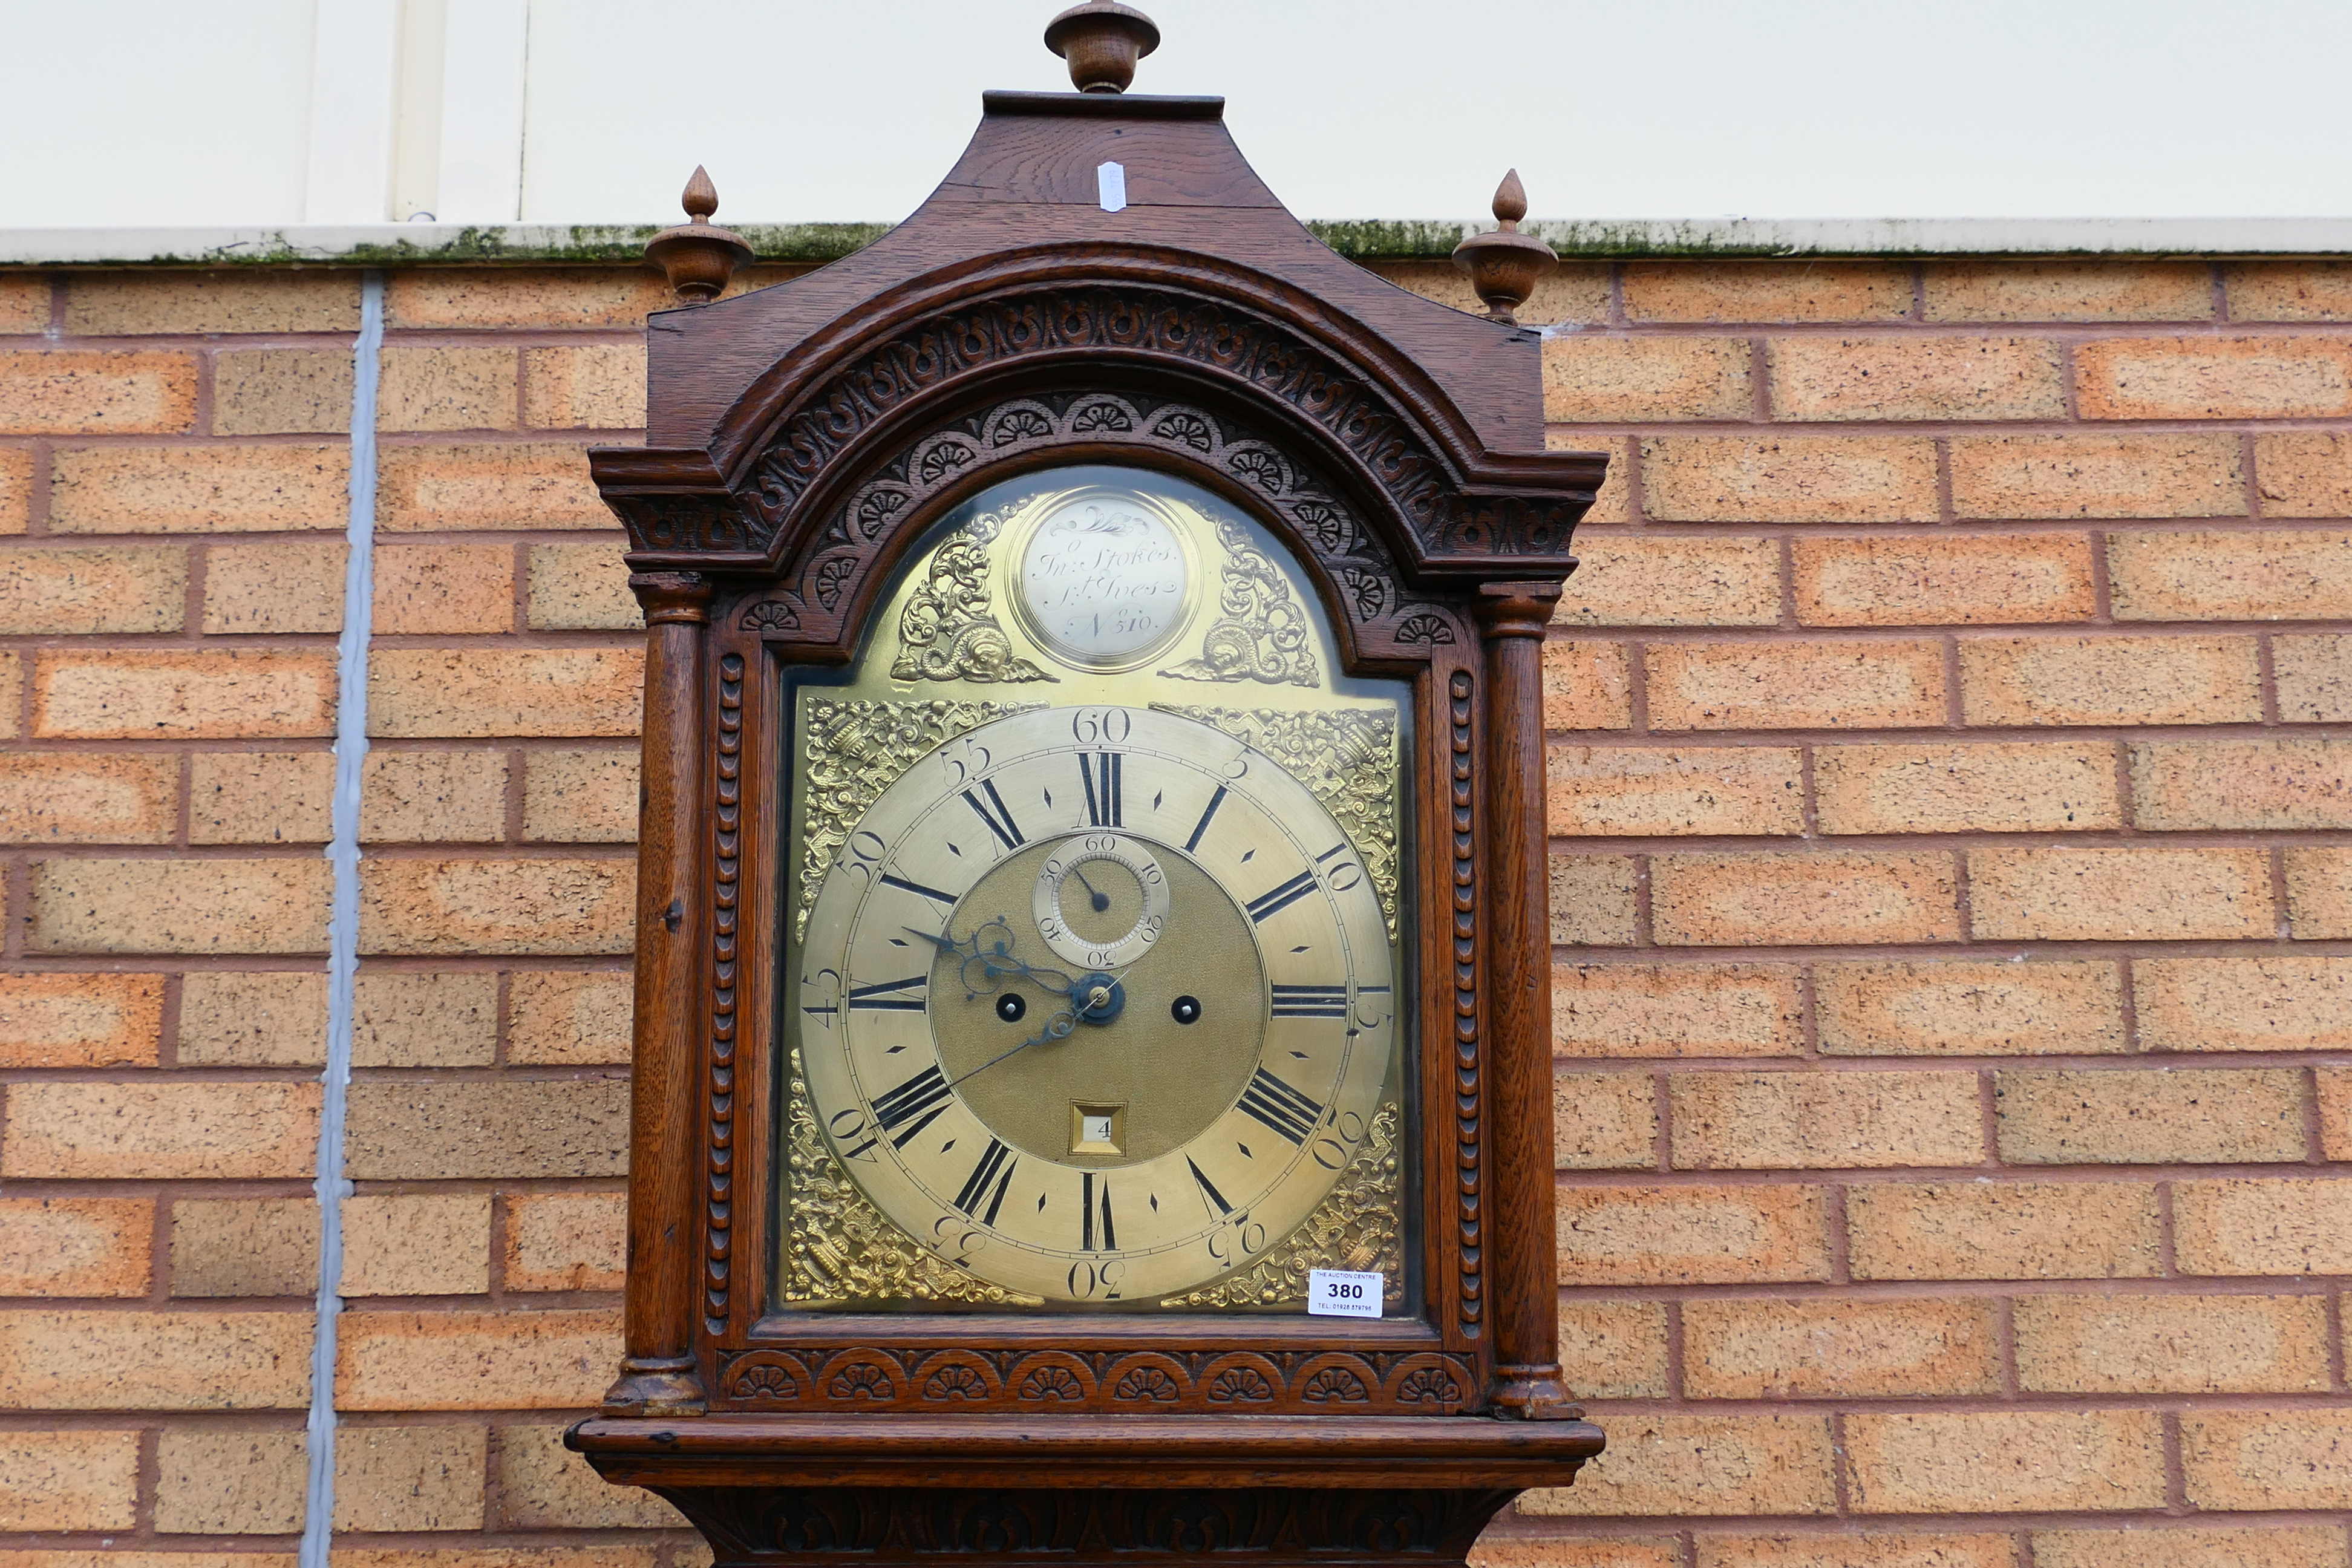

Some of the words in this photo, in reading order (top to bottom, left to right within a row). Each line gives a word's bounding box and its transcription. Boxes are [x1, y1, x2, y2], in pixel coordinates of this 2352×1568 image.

[1072, 708, 1131, 743] 60
[939, 734, 991, 788] 55
[1222, 747, 1254, 779] 5
[1071, 752, 1126, 829] XII
[958, 776, 1031, 862] XI
[1086, 836, 1116, 852] 60
[1180, 783, 1232, 857] I
[835, 831, 886, 890] 50
[1040, 860, 1061, 887] 50
[1141, 863, 1161, 884] 10
[1313, 841, 1362, 892] 10
[878, 857, 962, 925] X
[1241, 866, 1321, 929] II
[1040, 917, 1062, 942] 40
[1141, 915, 1163, 942] 20
[1087, 951, 1117, 967] 30
[801, 969, 841, 1029] 45
[849, 972, 928, 1015] IX
[1270, 979, 1347, 1022] III
[1357, 981, 1394, 1030] 15
[830, 1109, 878, 1163] 40
[1098, 1120, 1111, 1138] 4
[1312, 1108, 1363, 1170] 20
[947, 1134, 1020, 1229] VII
[1184, 1152, 1237, 1224] V
[1079, 1172, 1120, 1252] VI
[930, 1216, 987, 1269] 35
[1208, 1212, 1265, 1273] 25
[1068, 1260, 1125, 1299] 30
[1328, 1284, 1362, 1299] 380
